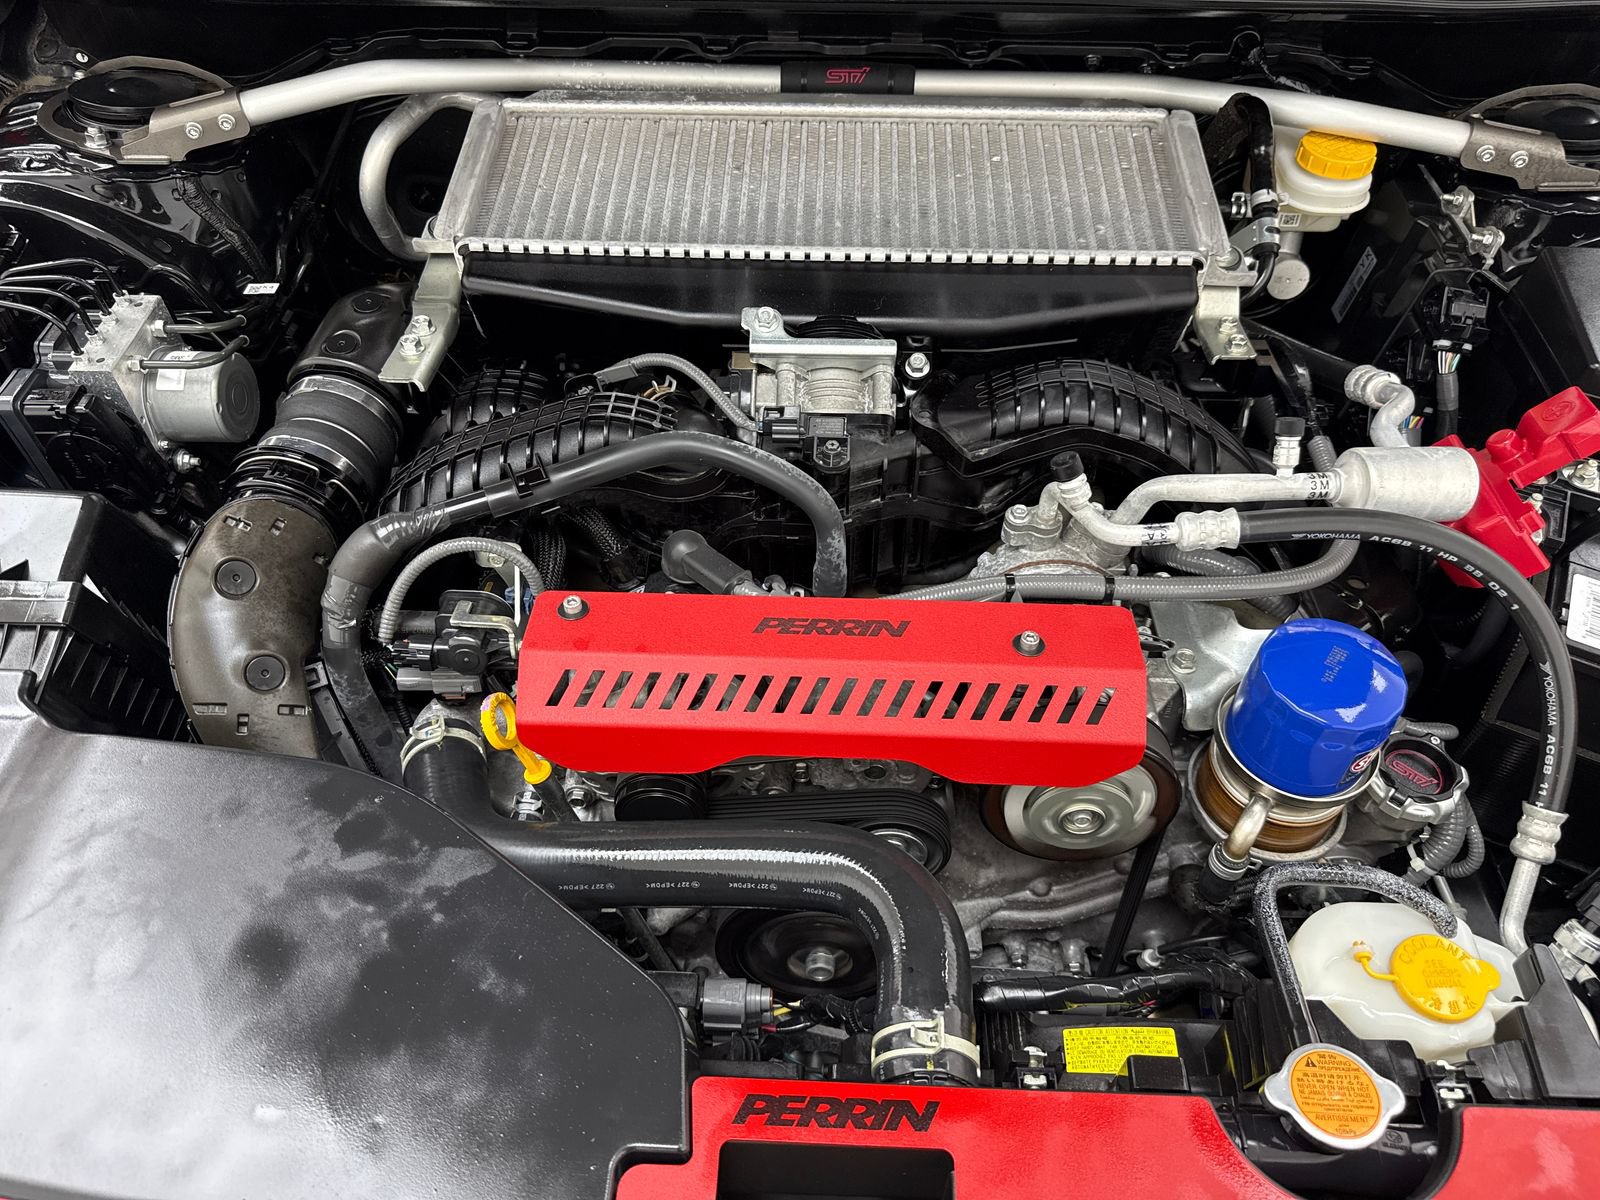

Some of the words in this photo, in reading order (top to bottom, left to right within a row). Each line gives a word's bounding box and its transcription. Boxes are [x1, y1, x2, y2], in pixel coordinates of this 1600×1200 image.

[1305, 532, 1361, 541] YOKOHAMA
[1418, 544, 1434, 553] 11
[1437, 551, 1459, 564] HP
[752, 617, 912, 638] PERRIN
[1543, 674, 1558, 727] YOKOHAMA
[1537, 782, 1549, 796] 11
[1398, 936, 1472, 965] COOLANT
[731, 1093, 941, 1133] PERRIN
[1315, 1113, 1369, 1123] AVERTISSEMENT
